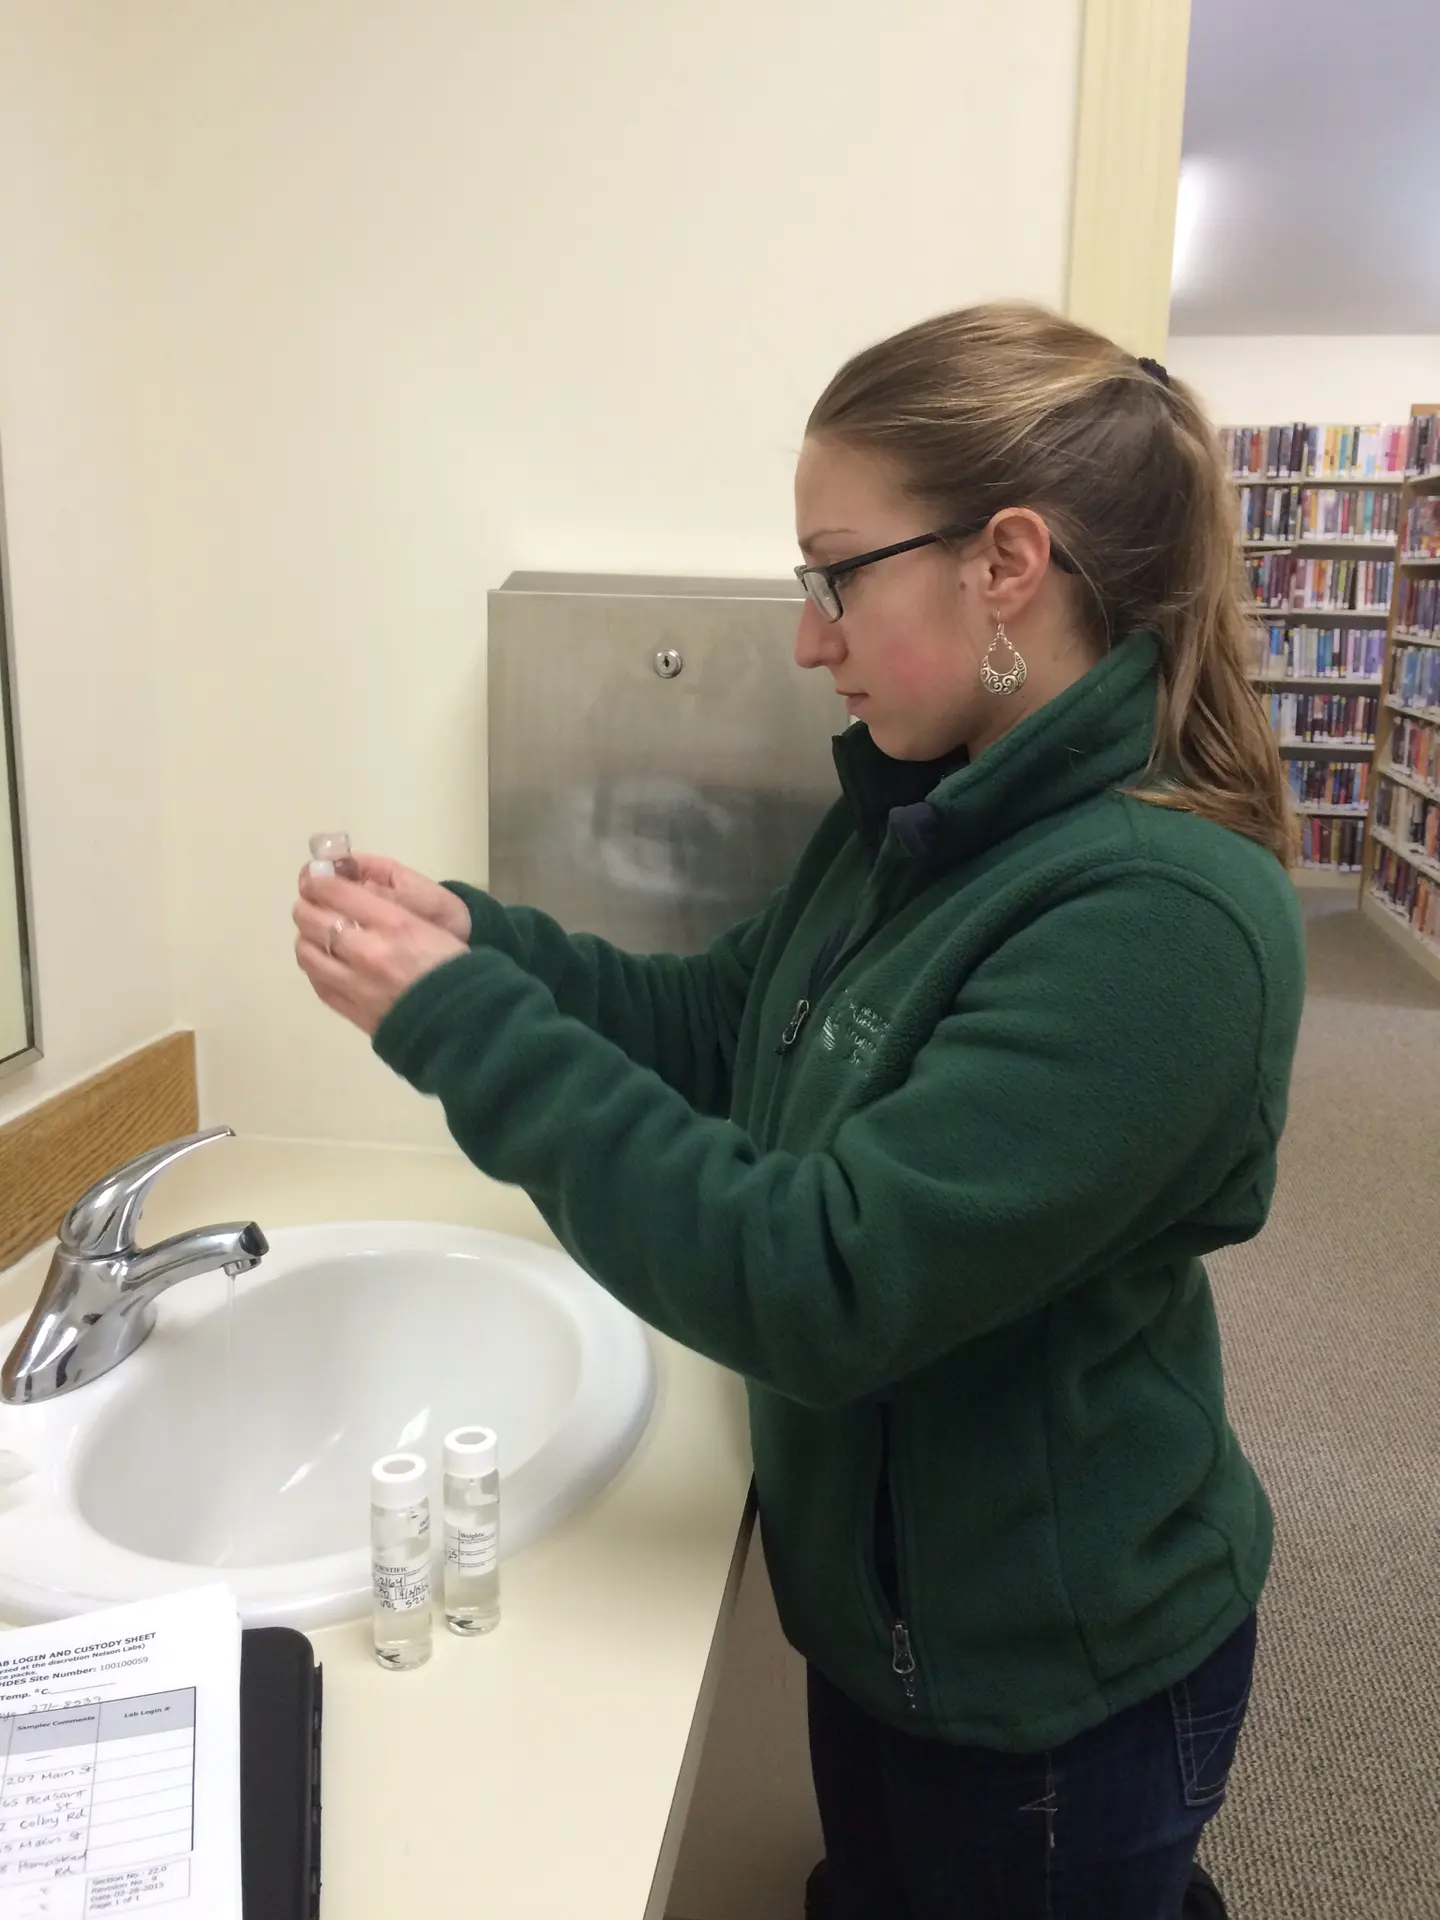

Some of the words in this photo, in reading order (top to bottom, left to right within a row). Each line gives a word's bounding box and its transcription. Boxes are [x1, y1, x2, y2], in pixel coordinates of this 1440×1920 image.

[373, 1562, 407, 1573] CIENTIFIC
[12, 1654, 46, 1665] LOGIN
[49, 1649, 72, 1659] AND
[74, 1640, 122, 1654] CUSTODY
[124, 1632, 157, 1645] SHEET
[32, 1661, 46, 1669] the
[48, 1655, 90, 1666] discretion
[92, 1649, 121, 1658] Nelson
[123, 1643, 146, 1653] Labs)
[29, 1674, 50, 1683] Site
[52, 1667, 97, 1679] Number:
[100, 1656, 149, 1671] 100100059
[0, 1692, 32, 1701] Temp.
[140, 1708, 162, 1717] Login
[17, 1722, 51, 1731] Sampler
[52, 1716, 96, 1726] Comments
[6, 1774, 35, 1786] 207
[41, 1770, 75, 1781] Main
[26, 1789, 87, 1805] Pleasant
[20, 1814, 59, 1830] Colby
[66, 1808, 87, 1822] Rd
[19, 1837, 62, 1849] Main
[54, 1866, 76, 1877] Rd
[92, 1876, 124, 1885] Section
[147, 1865, 168, 1876] 22.0
[91, 1883, 128, 1894] Revision
[89, 1901, 112, 1911] Page
[122, 1896, 132, 1904] of
